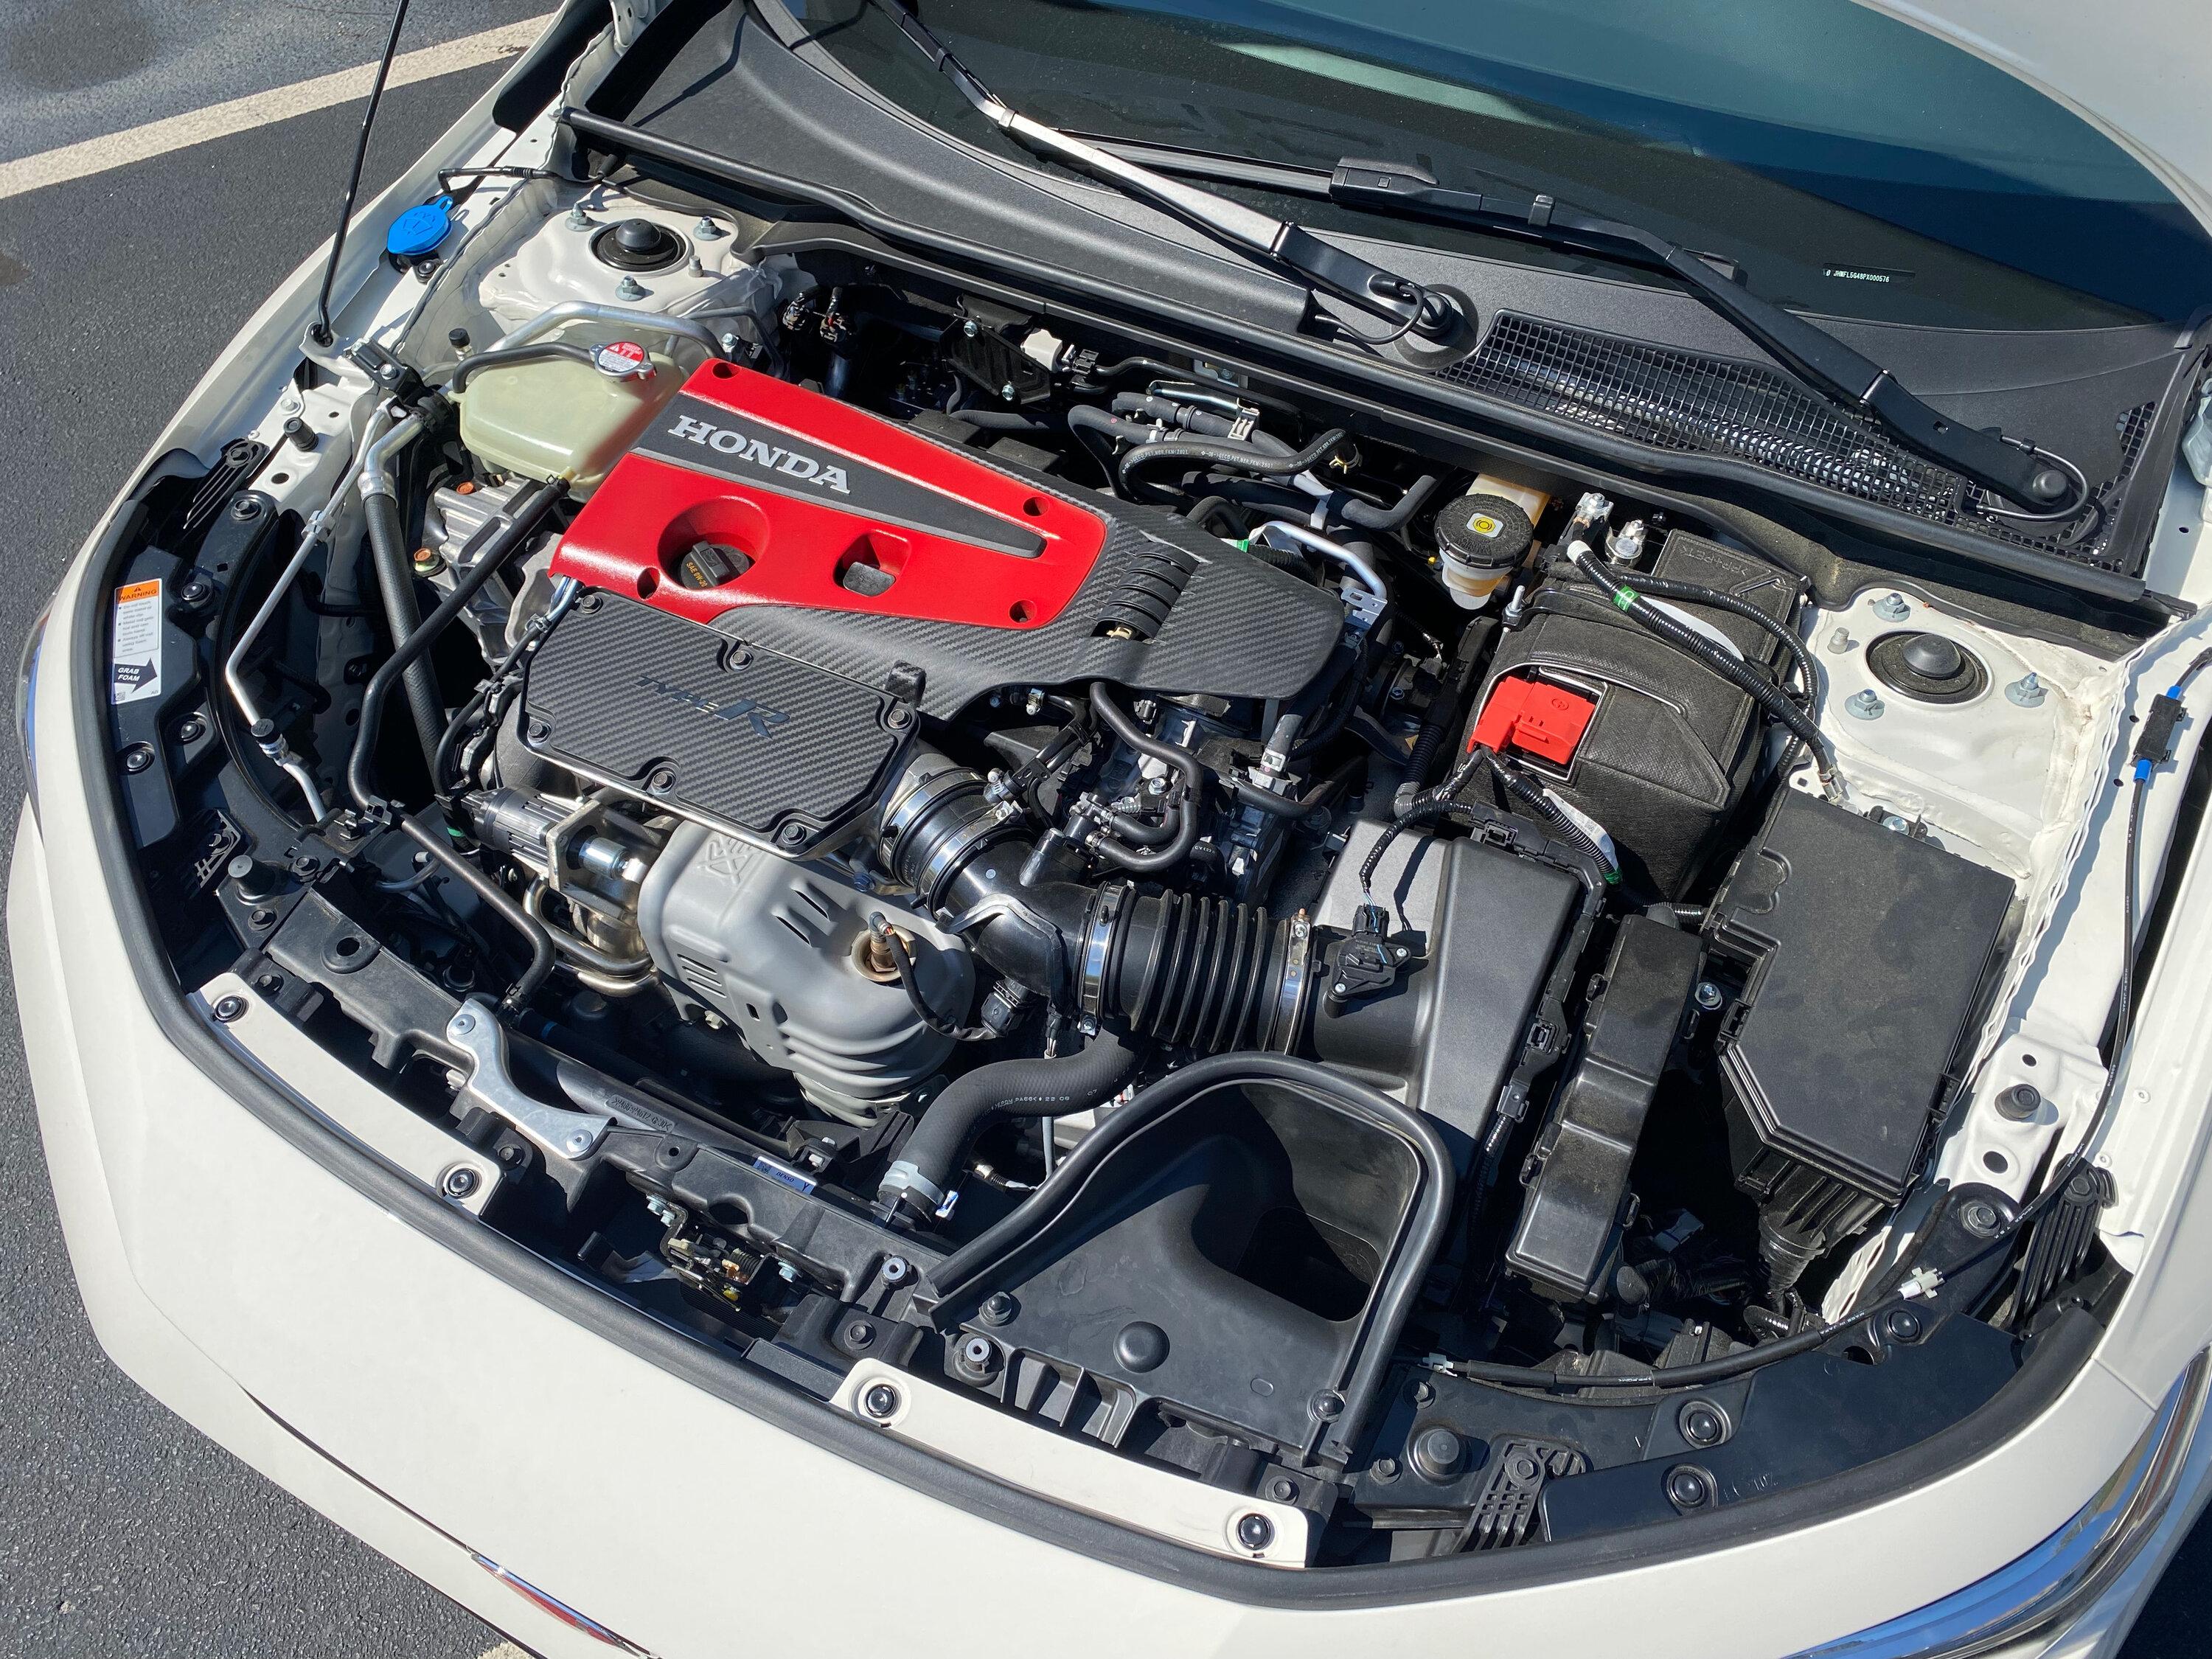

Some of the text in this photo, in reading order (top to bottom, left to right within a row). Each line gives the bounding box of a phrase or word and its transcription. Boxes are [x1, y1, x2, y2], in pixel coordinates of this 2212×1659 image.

[1833, 270, 1890, 282] JHMFL5G48PX000576
[667, 415, 851, 495] HONDA
[686, 562, 708, 587] SAE 0W-20
[119, 589, 157, 601] WARNING
[635, 676, 790, 740] TYPE R
[776, 1172, 810, 1192] DENSO Y
